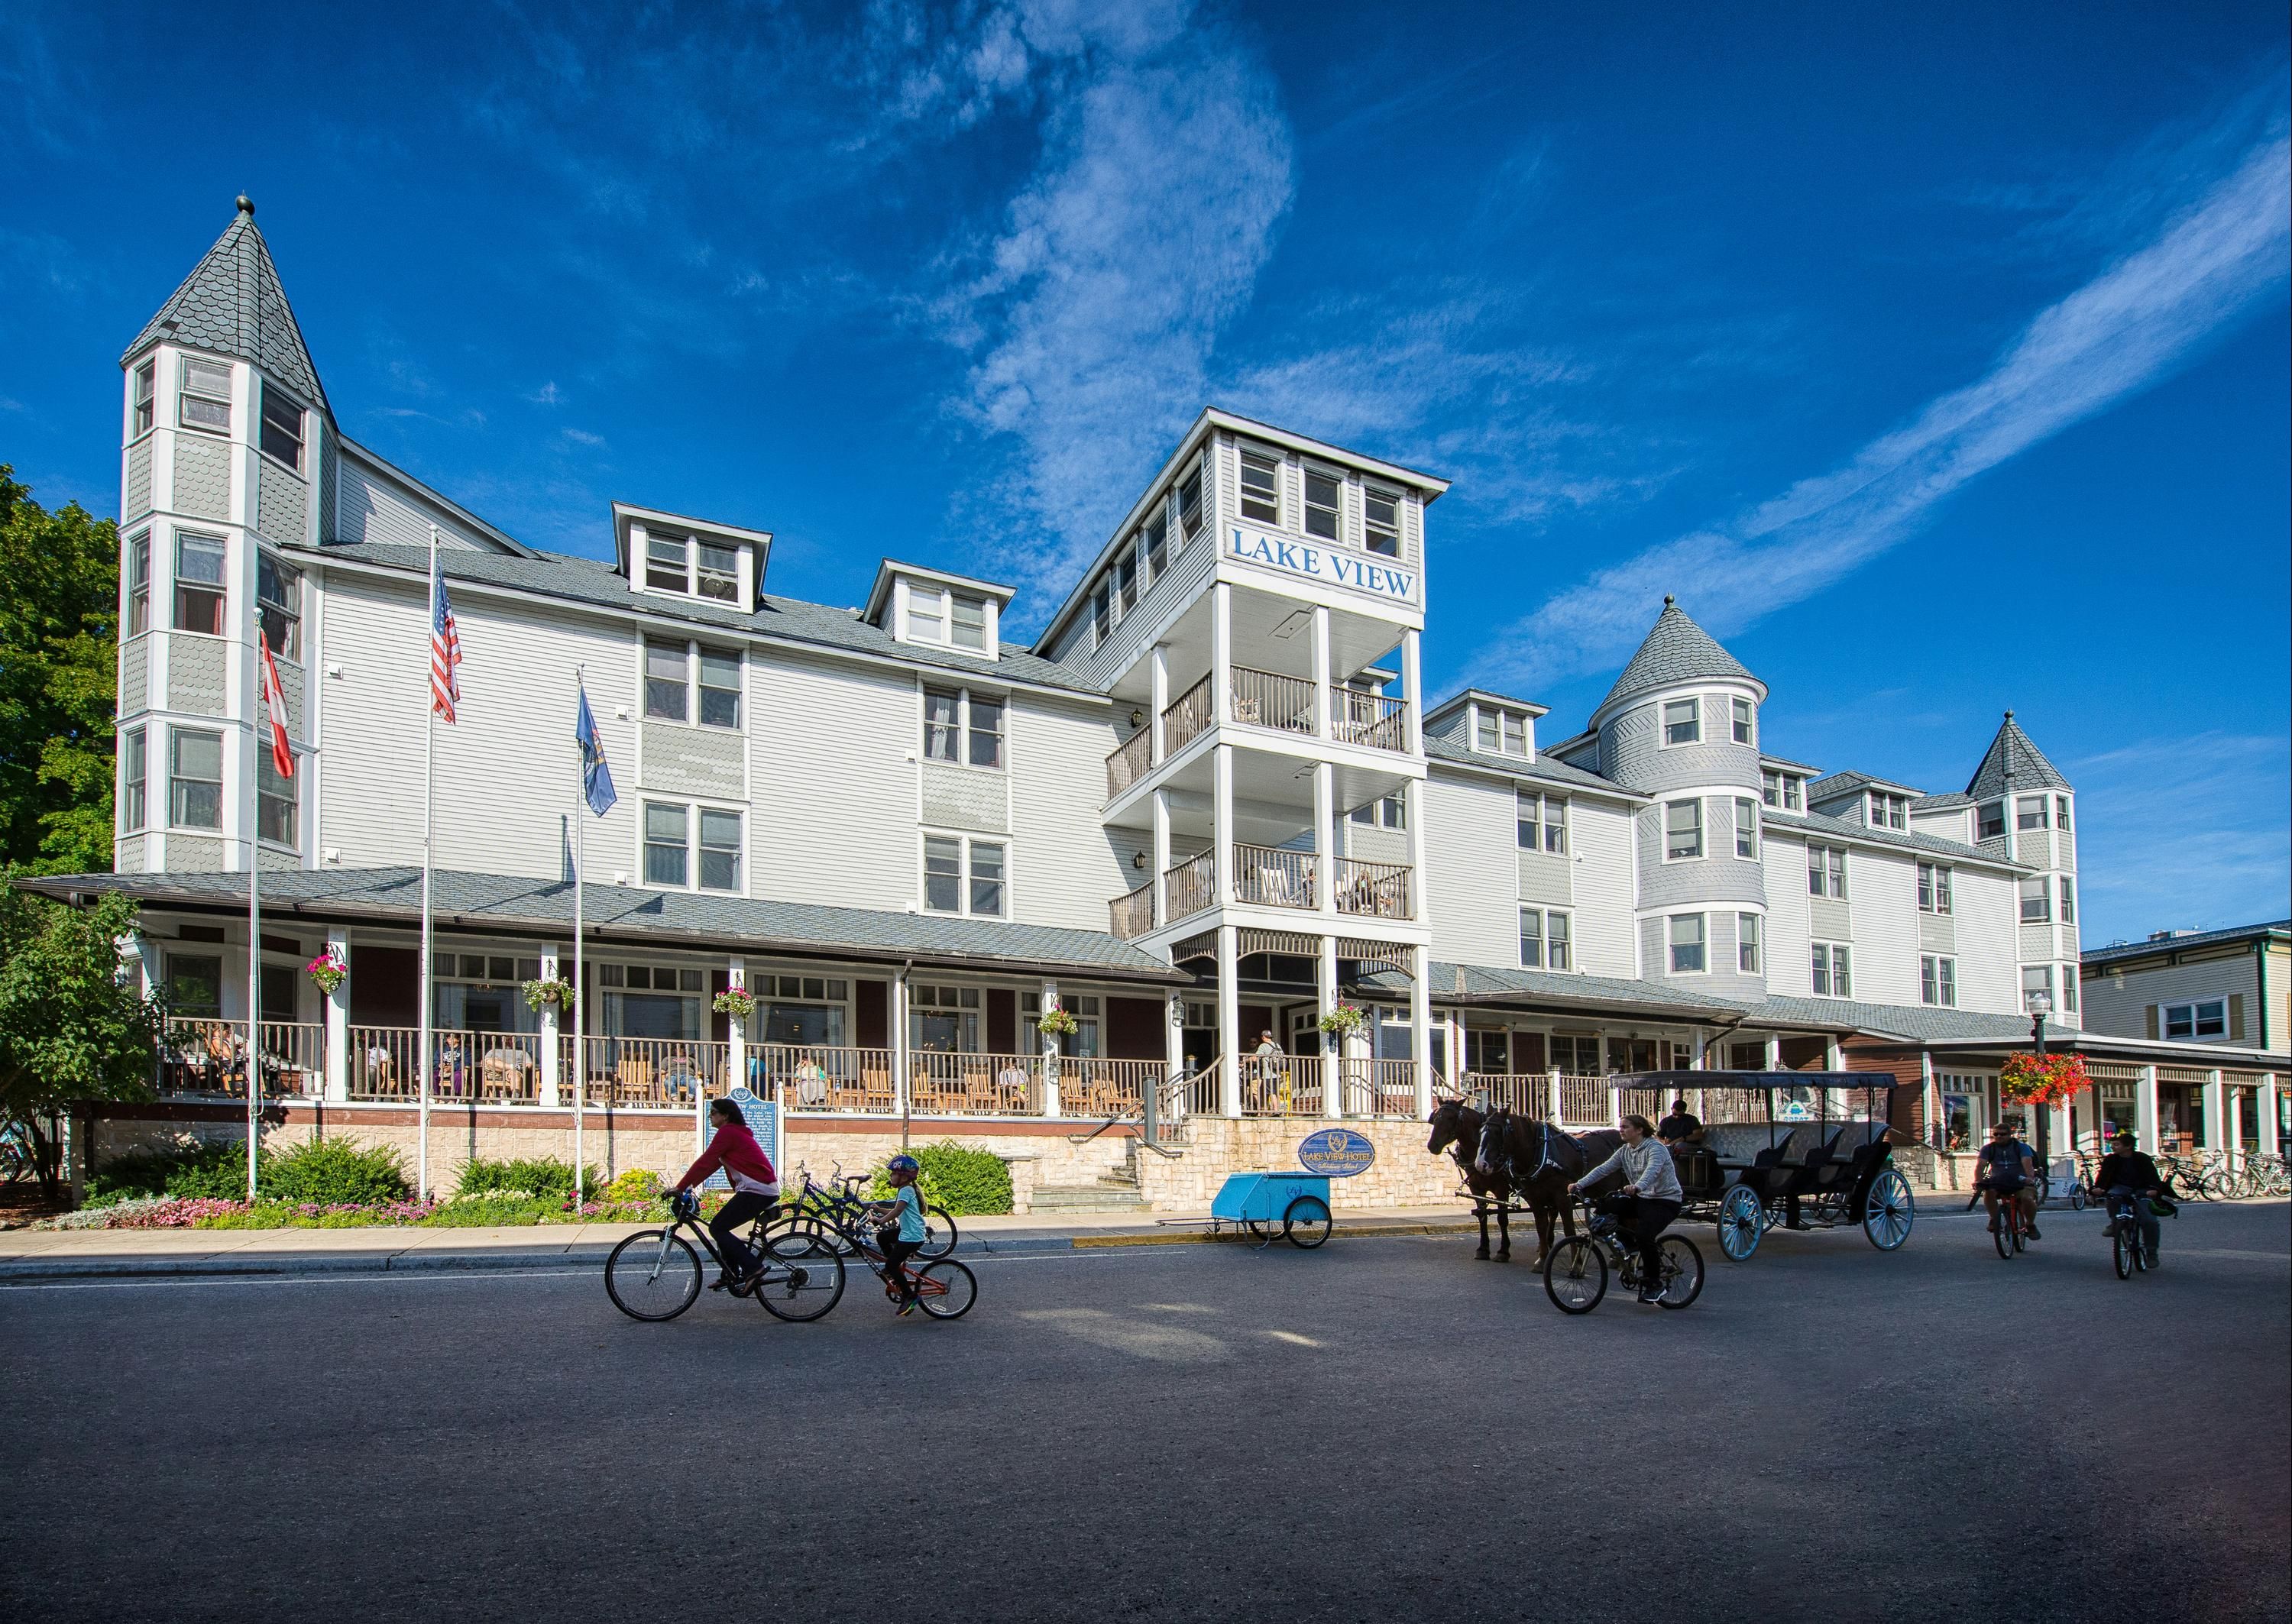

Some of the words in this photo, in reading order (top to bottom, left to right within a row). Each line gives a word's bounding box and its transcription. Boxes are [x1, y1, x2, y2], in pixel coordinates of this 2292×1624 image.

[1232, 528, 1320, 574] LAKE
[1330, 555, 1413, 597] VIEW
[1303, 1151, 1323, 1160] LAKE
[1324, 1151, 1345, 1160] VIEW
[1346, 1151, 1371, 1160] HOTEL
